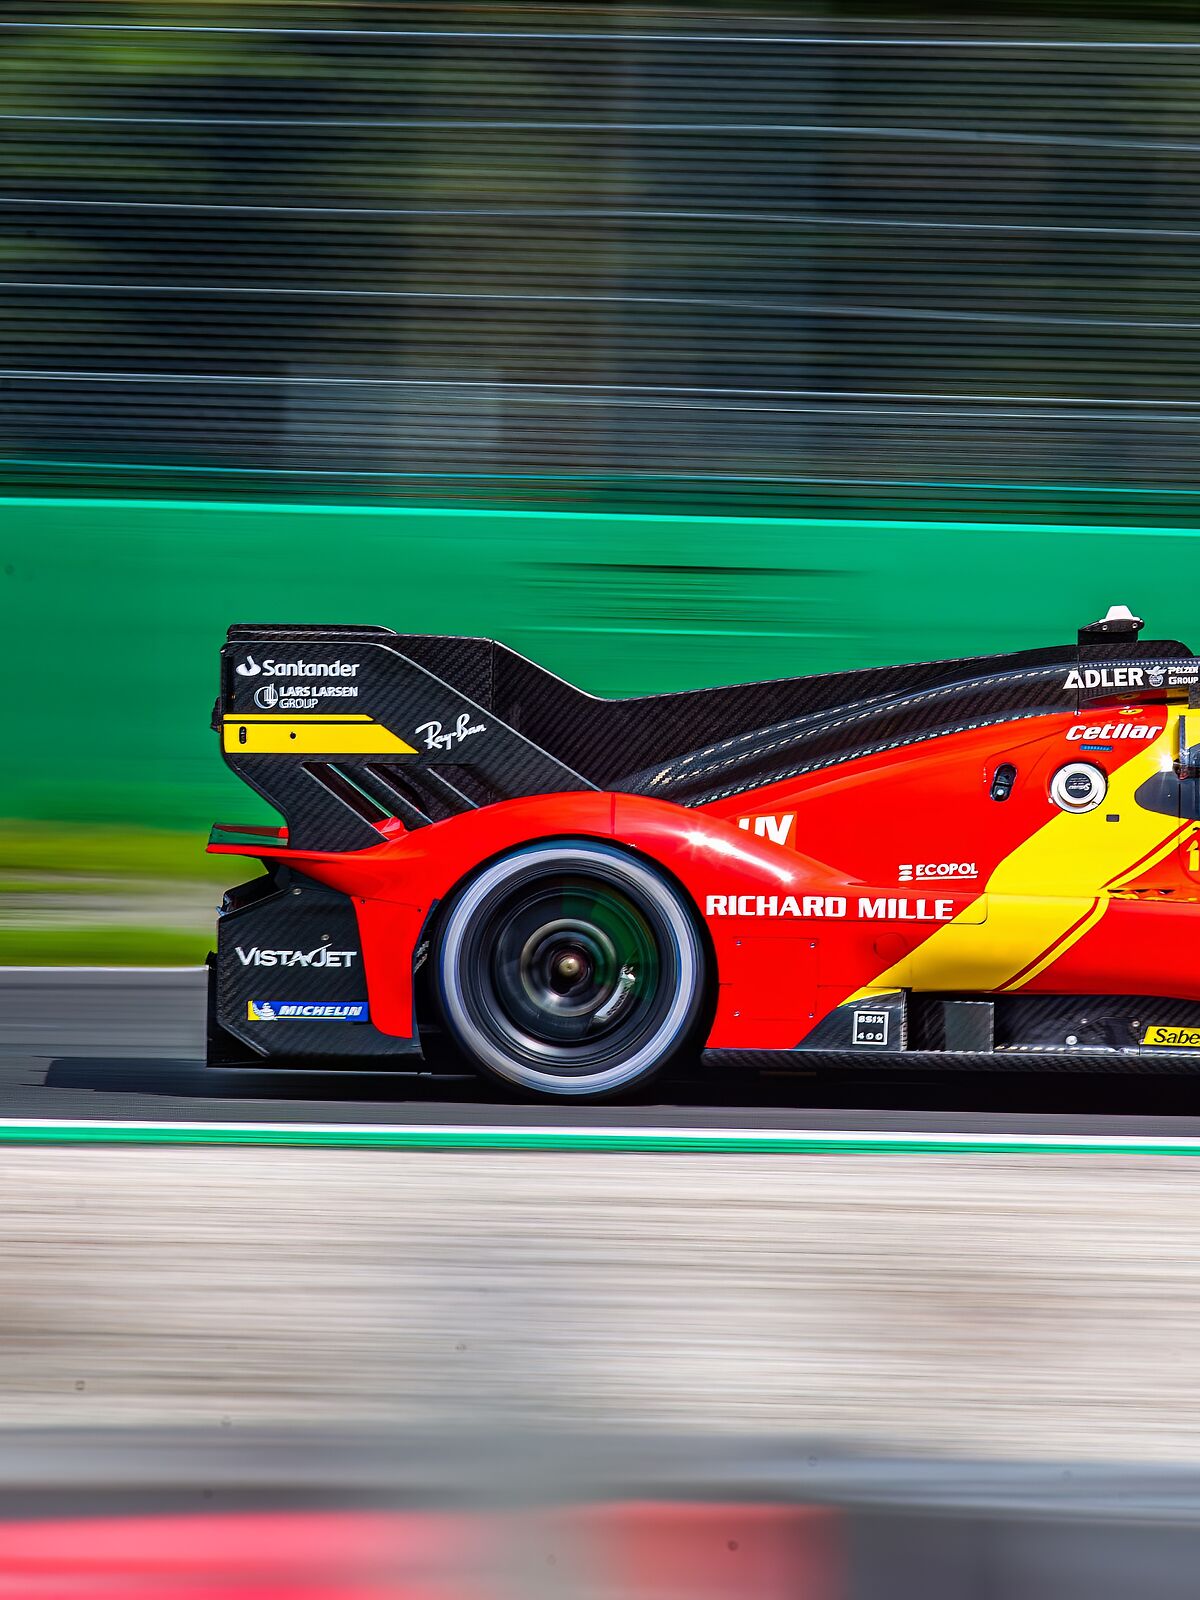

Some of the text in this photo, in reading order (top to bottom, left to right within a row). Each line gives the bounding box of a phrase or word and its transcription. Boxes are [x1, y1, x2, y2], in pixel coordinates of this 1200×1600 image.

[262, 659, 360, 677] Santander
[1167, 666, 1199, 674] PELZER
[1062, 667, 1144, 689] ADLER
[1168, 676, 1199, 685] GROUP
[279, 686, 359, 697] LARS LARSEN
[279, 698, 319, 709] GROUP
[915, 863, 979, 876] ECOPOL
[706, 895, 954, 920] RICHARD MILLE
[278, 1005, 363, 1017] MICHELIN
[857, 1032, 883, 1041] 400
